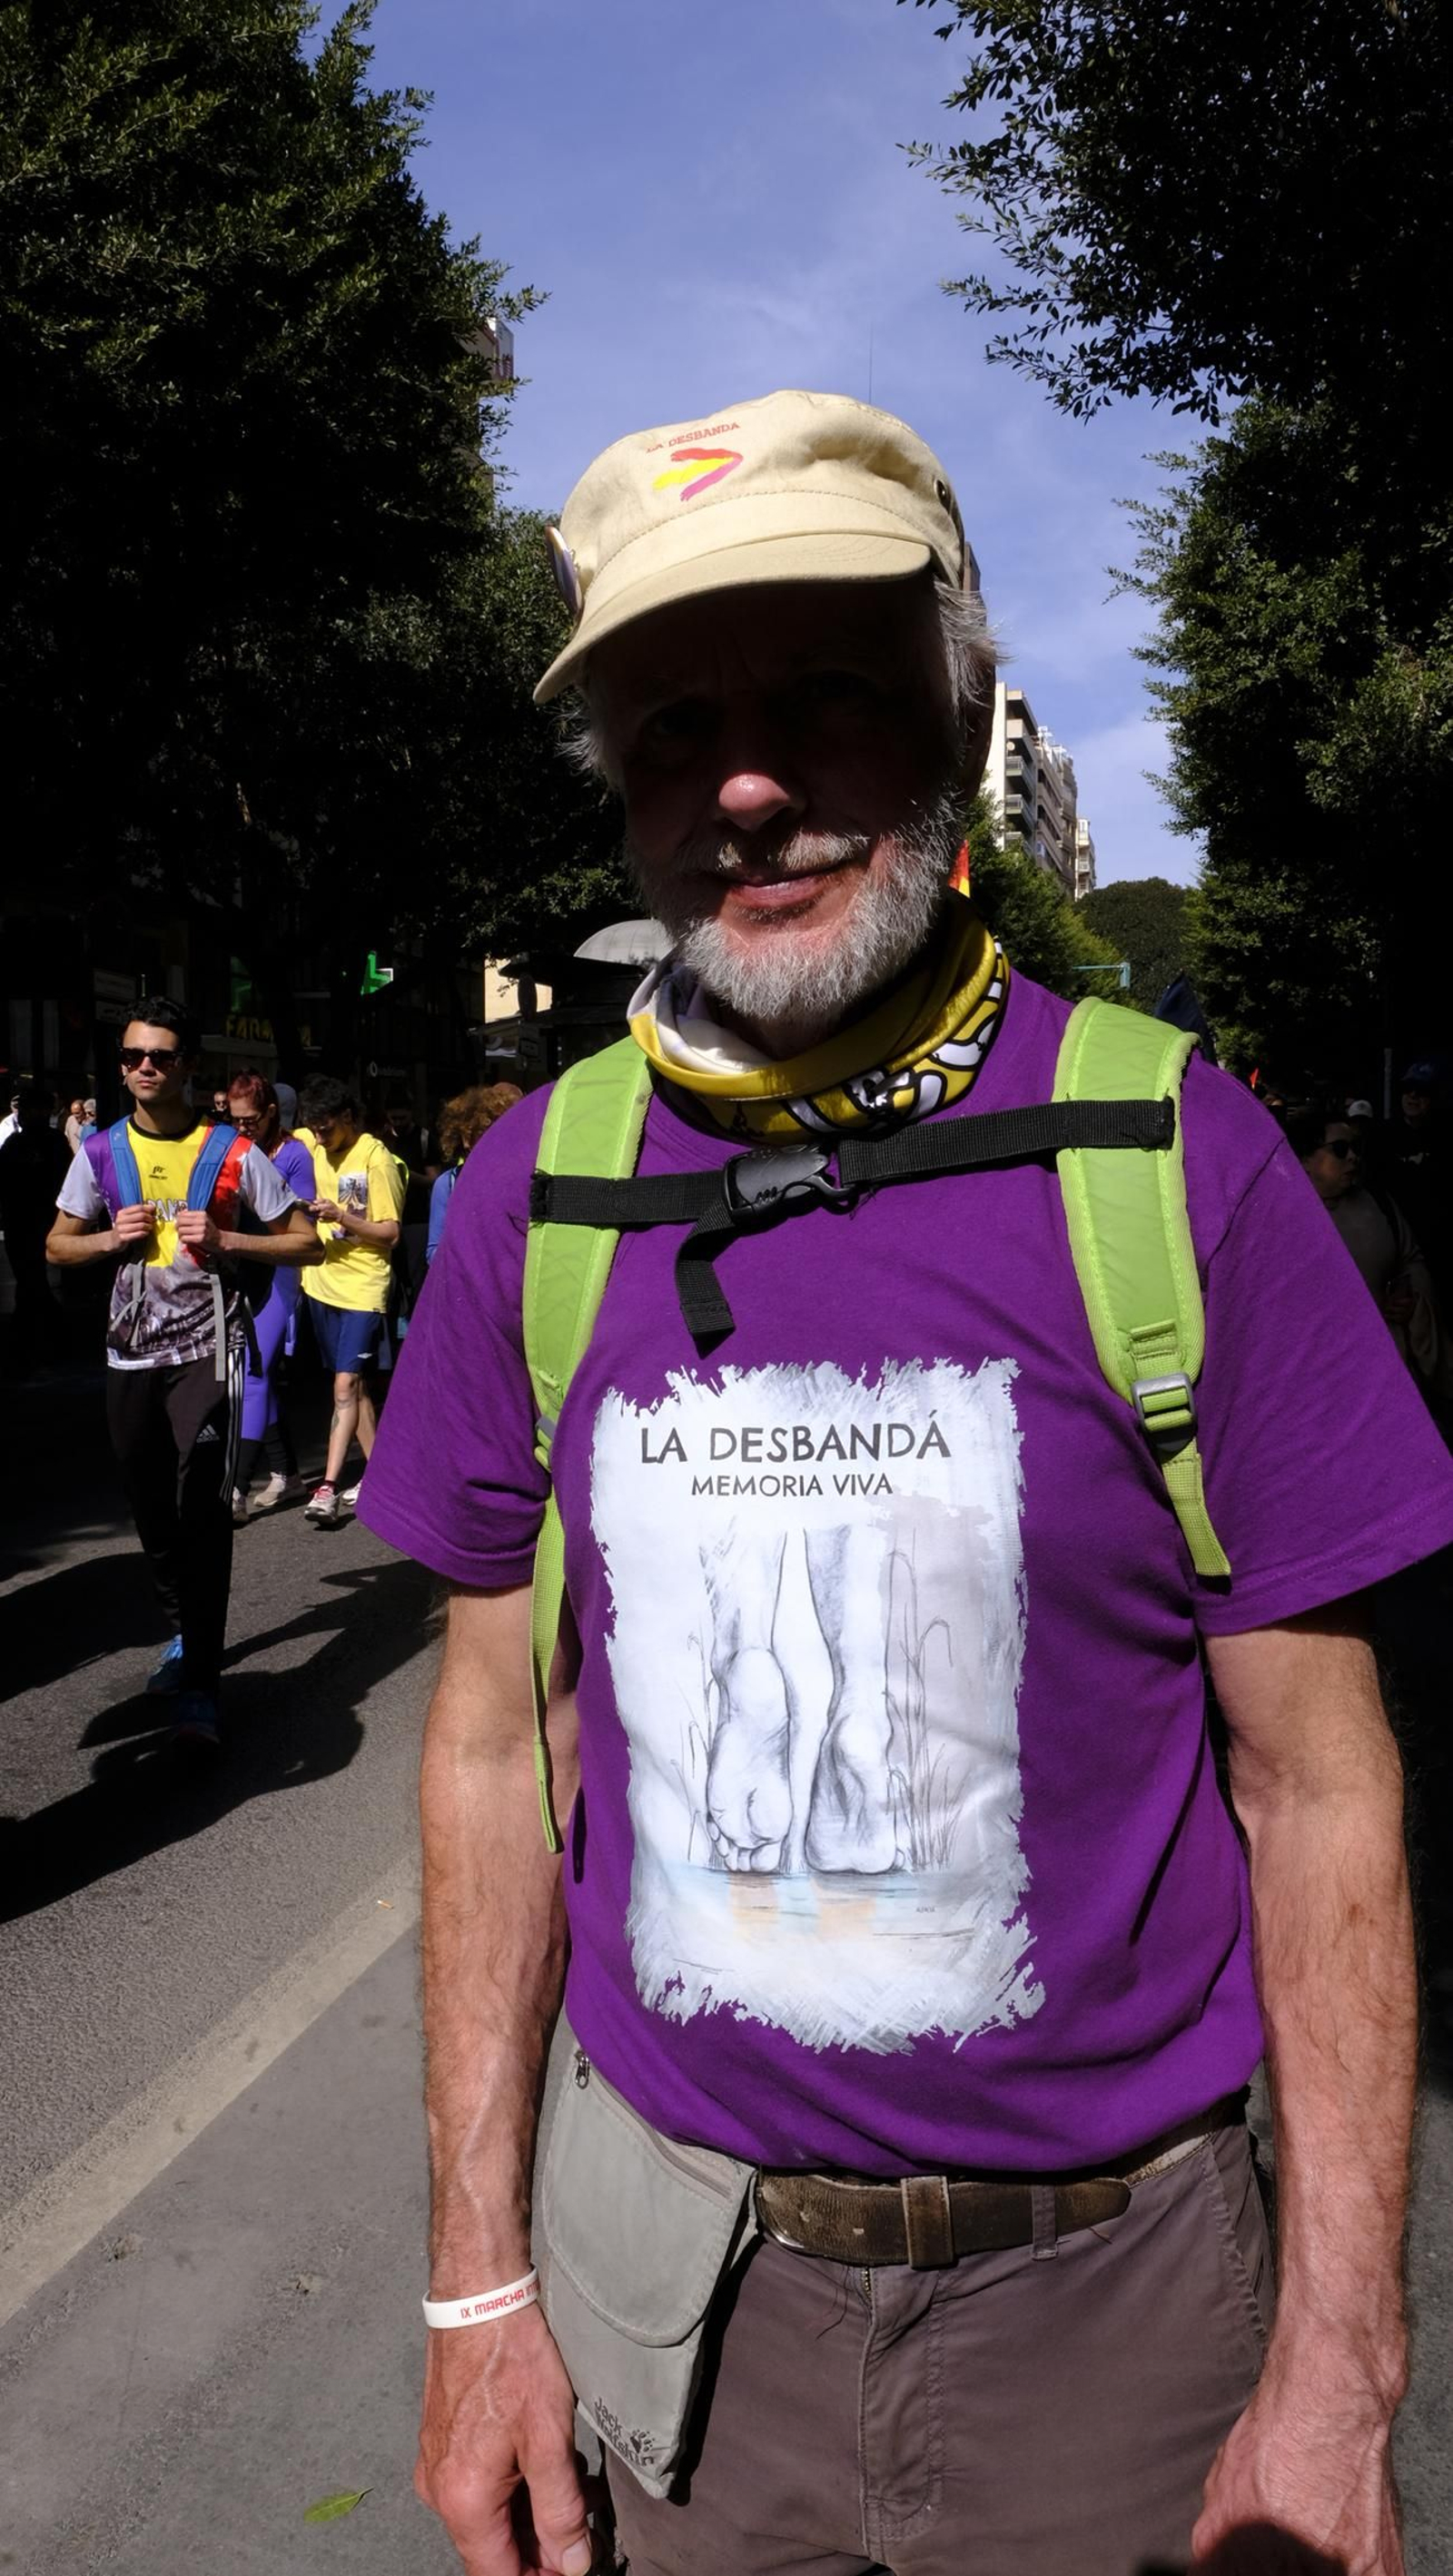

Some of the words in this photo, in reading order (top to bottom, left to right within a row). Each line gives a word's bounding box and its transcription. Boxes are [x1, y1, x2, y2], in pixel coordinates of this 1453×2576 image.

[641, 1427, 688, 1464] LA
[709, 1409, 952, 1463] DESBANDÁ
[691, 1474, 824, 1497] MEMORIA
[833, 1472, 894, 1496] VIVA
[460, 2307, 471, 2319] IX
[474, 2289, 524, 2315] MARCHA
